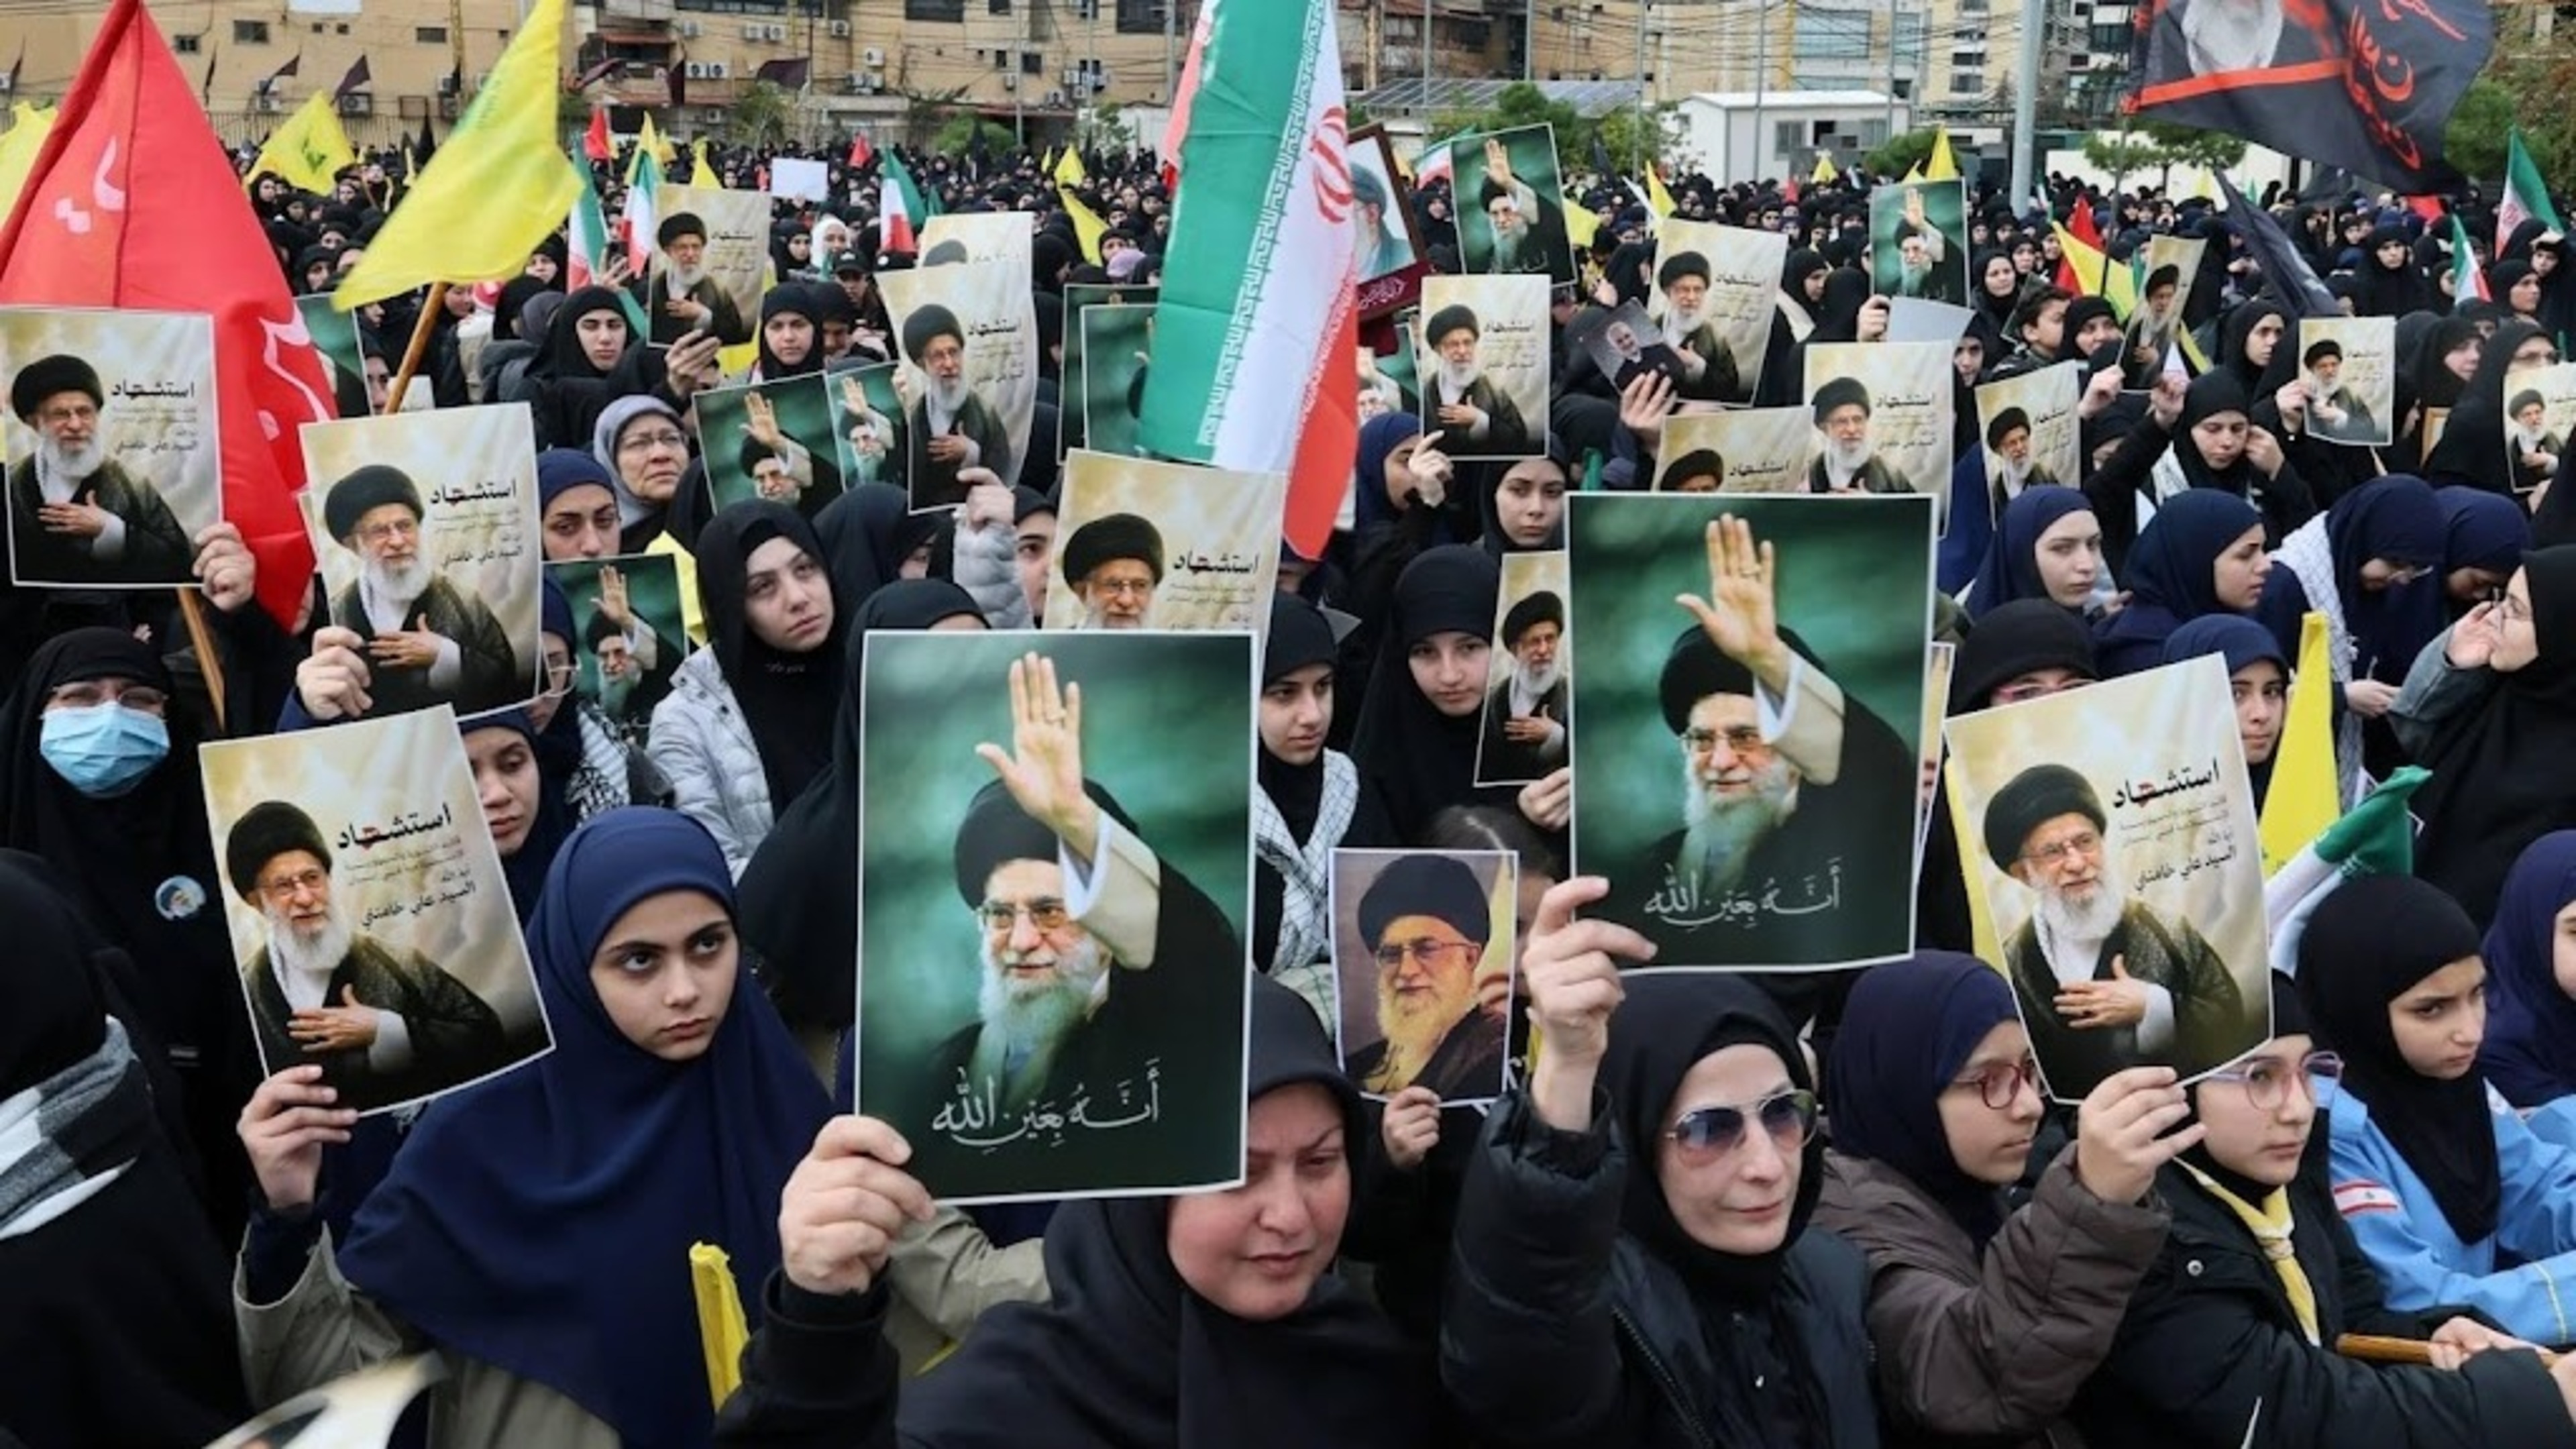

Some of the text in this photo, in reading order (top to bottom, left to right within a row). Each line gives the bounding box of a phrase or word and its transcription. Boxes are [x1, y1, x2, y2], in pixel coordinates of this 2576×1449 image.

[111, 378, 195, 400] استشهاد
[429, 477, 517, 508] استشهاد
[1173, 549, 1260, 576] استشهاد
[2112, 757, 2220, 809] استشهاد
[337, 802, 451, 850] استشهاد
